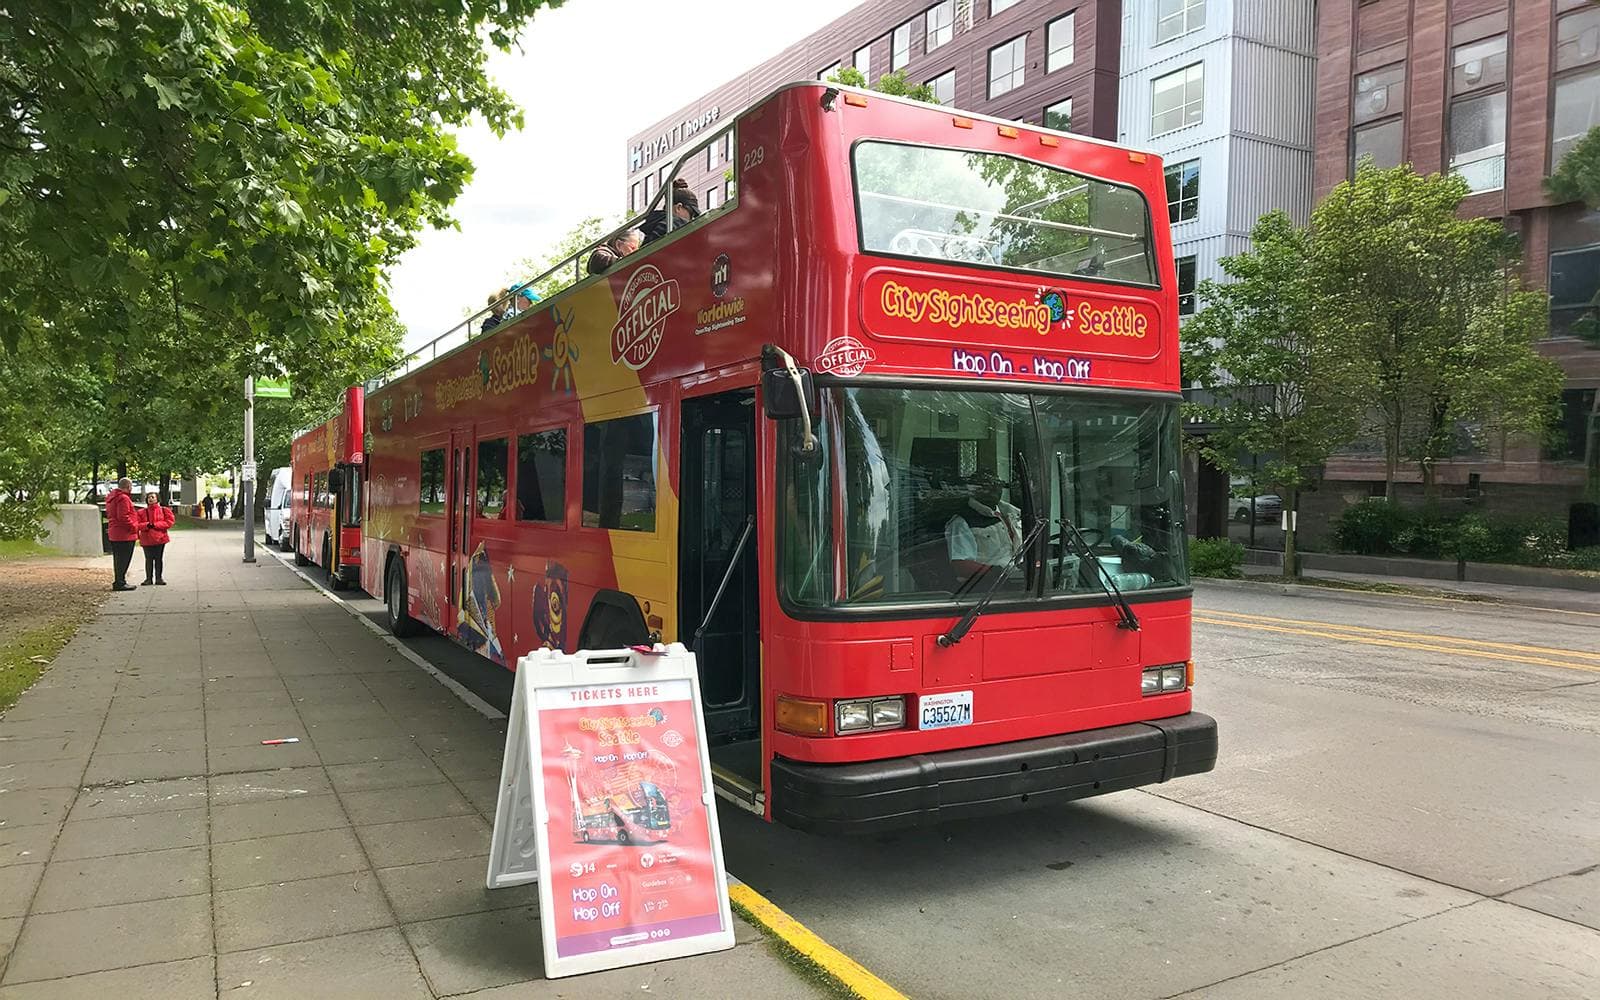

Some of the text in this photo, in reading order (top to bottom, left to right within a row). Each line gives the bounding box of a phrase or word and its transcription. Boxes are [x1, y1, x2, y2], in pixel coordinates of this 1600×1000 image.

[644, 122, 686, 163] HYATT
[685, 105, 720, 138] house
[743, 145, 764, 172] 229
[616, 285, 676, 352] OFFICIAL
[1078, 302, 1147, 338] Seattle
[633, 327, 660, 361] TOUR
[493, 333, 540, 395] Seattle
[821, 350, 873, 369] OFFICIAL
[953, 351, 987, 375] Hop
[990, 352, 1013, 374] On
[1034, 358, 1064, 380] Hop
[1067, 360, 1091, 379] Off
[571, 686, 659, 701] TICKETS HERE
[599, 730, 641, 747] Seattle
[572, 883, 618, 902] Hop On
[574, 901, 621, 921] Hop Off
